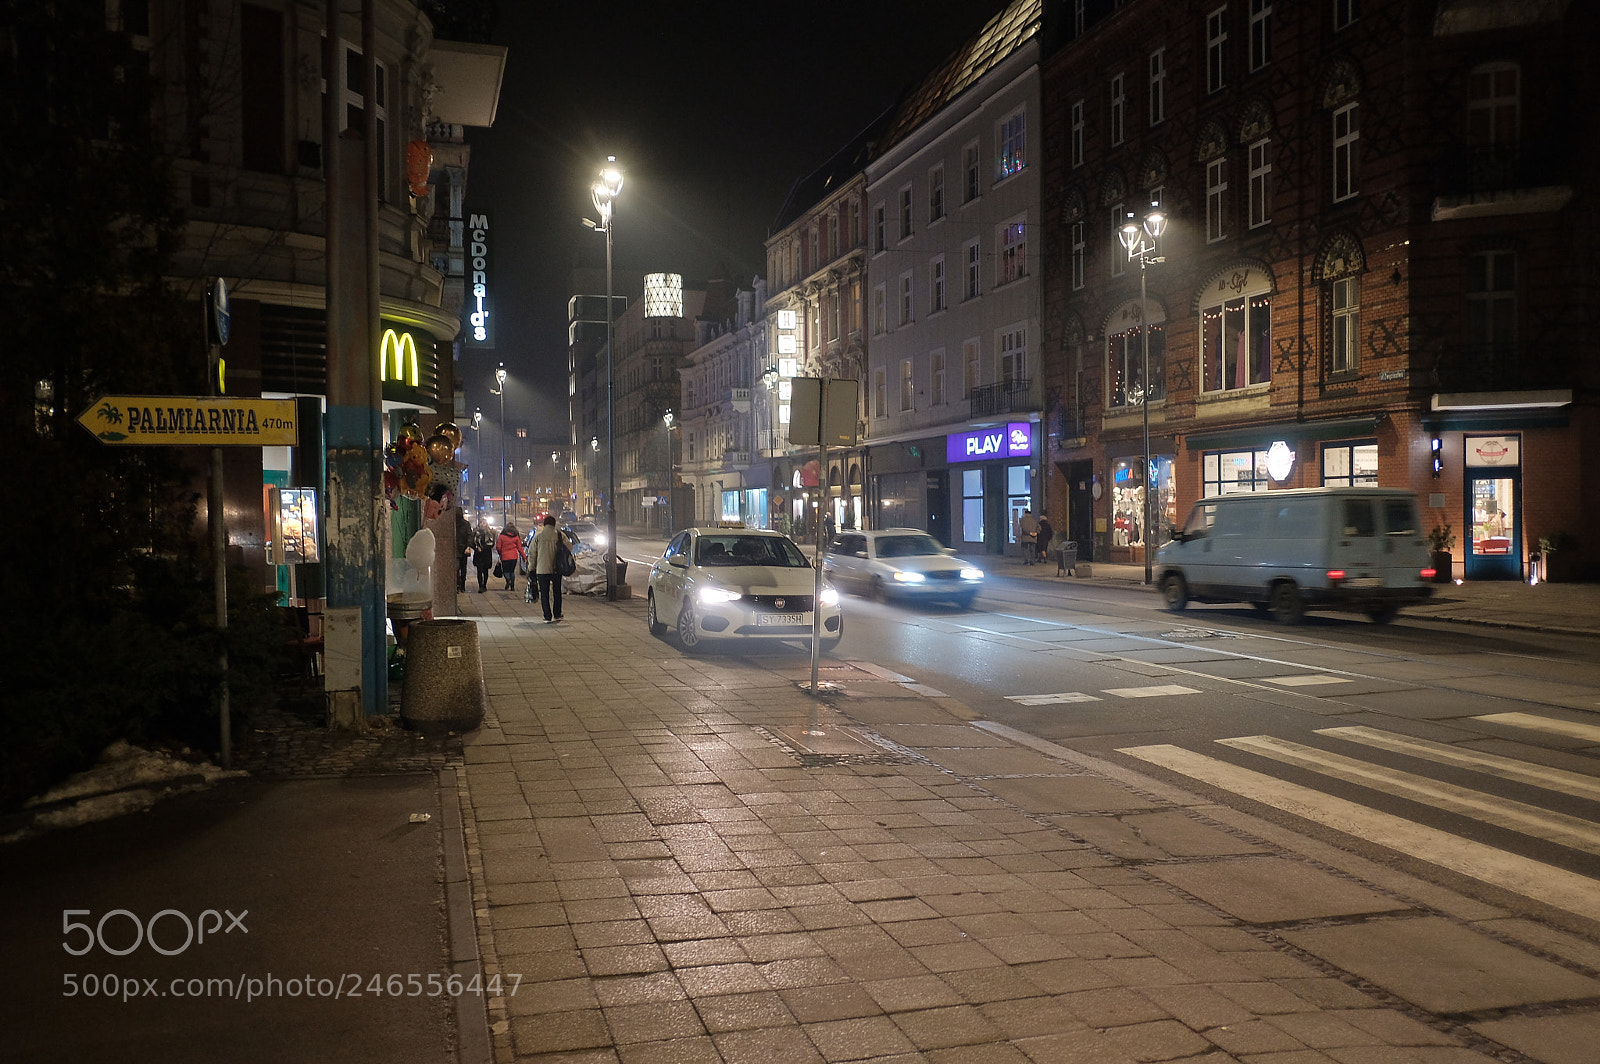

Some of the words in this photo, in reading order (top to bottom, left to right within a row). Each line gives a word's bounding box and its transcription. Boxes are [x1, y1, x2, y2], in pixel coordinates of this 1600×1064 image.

[469, 213, 489, 341] McDonald's
[127, 407, 260, 434] PALMIARNIA
[262, 417, 293, 430] 470m
[966, 433, 1003, 455] PLAY
